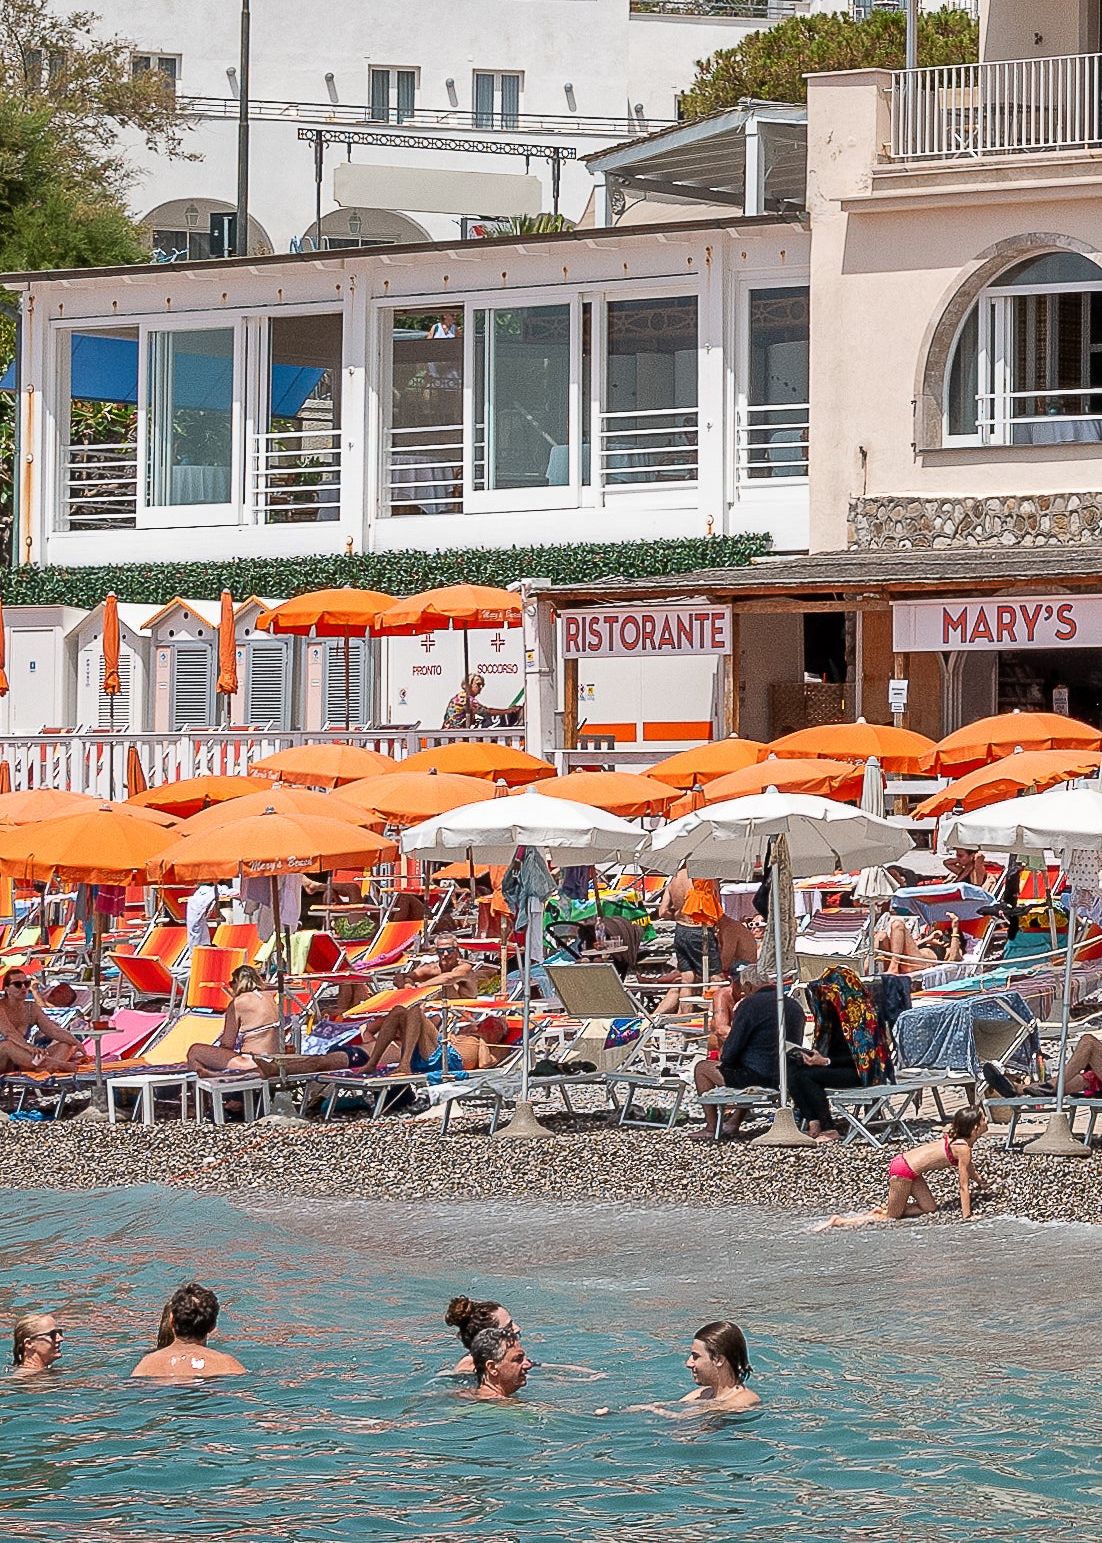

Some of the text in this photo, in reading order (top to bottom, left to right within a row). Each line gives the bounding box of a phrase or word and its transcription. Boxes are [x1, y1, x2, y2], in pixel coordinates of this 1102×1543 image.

[565, 612, 725, 652] RISTORANTE
[942, 603, 1078, 644] MARY'S
[412, 663, 518, 675] PRONTO SOCCORSO
[250, 855, 313, 872] Mary's Beach
